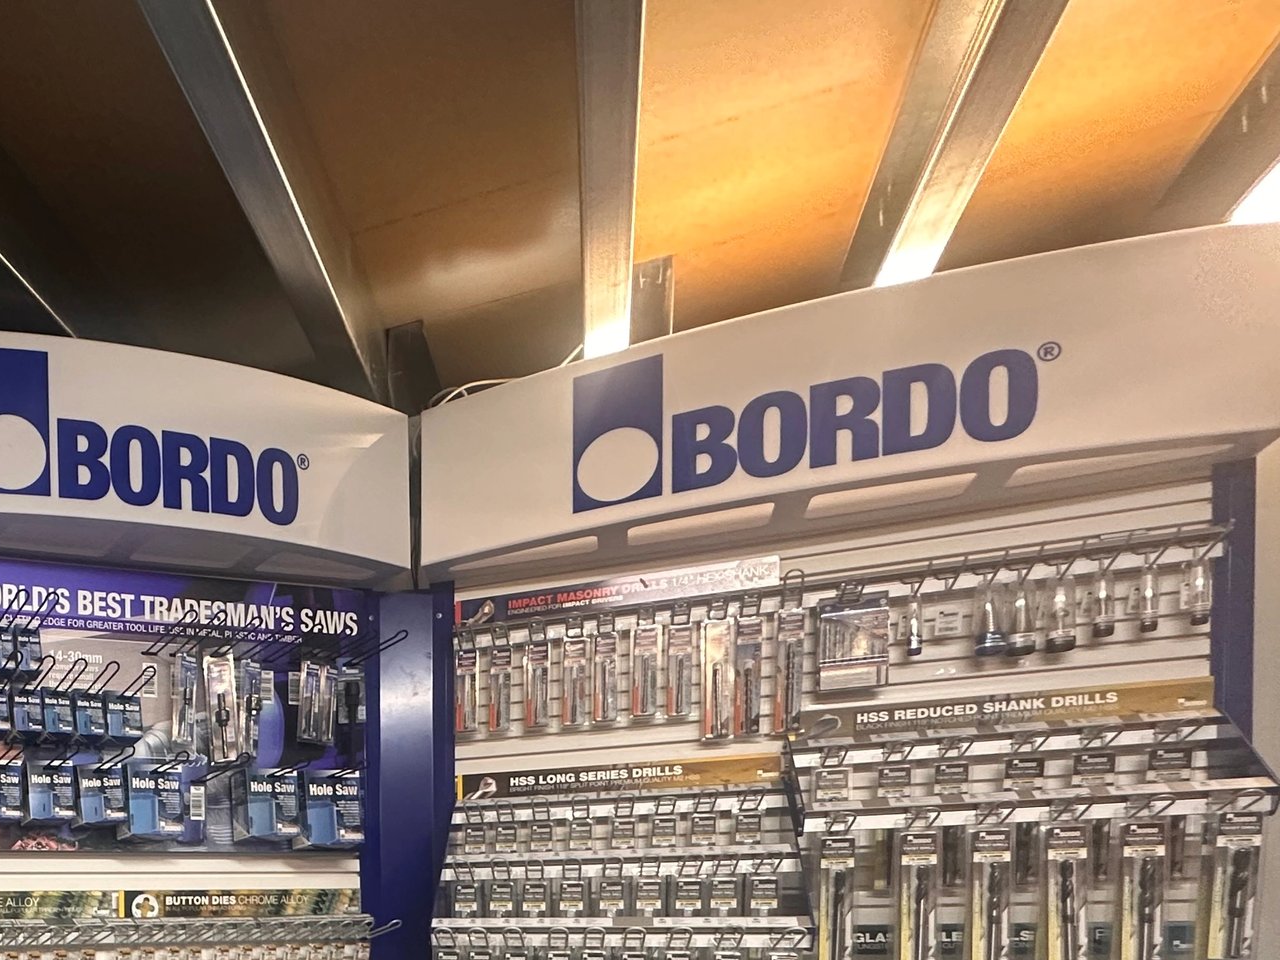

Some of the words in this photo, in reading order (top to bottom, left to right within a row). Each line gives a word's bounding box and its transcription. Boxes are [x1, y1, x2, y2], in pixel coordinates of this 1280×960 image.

[507, 594, 554, 609] IMPACT
[556, 585, 619, 604] MASONRY
[77, 590, 135, 620] BEST
[140, 595, 294, 632] TRADESMAN'S
[300, 607, 359, 637] SAWS
[67, 618, 84, 628] FOR
[86, 619, 124, 631] GREATER
[125, 622, 147, 633] TOOL
[856, 712, 889, 724] HSS
[894, 704, 978, 721] REDUCED
[983, 699, 1045, 713] SHANK
[1050, 692, 1118, 707] DRILLS
[0, 774, 19, 784] Saw
[31, 774, 51, 784] Hole
[53, 775, 71, 784] Saw
[510, 776, 536, 786] HSS
[539, 773, 575, 785] LONG
[579, 770, 629, 782] SERIES
[632, 765, 683, 778] DRILLS
[82, 778, 101, 788] Hole
[103, 777, 120, 787] Saw
[132, 777, 155, 789] Hole
[158, 778, 179, 789] Saw
[250, 781, 272, 792] Hole
[275, 782, 295, 793] Saw
[309, 784, 333, 796] Hole
[336, 785, 358, 796] Saw
[5, 897, 39, 908] ALLOY
[165, 896, 209, 905] BUTTON
[212, 896, 236, 905] DIES
[238, 895, 279, 904] CHROME
[282, 895, 309, 904] ALLOY
